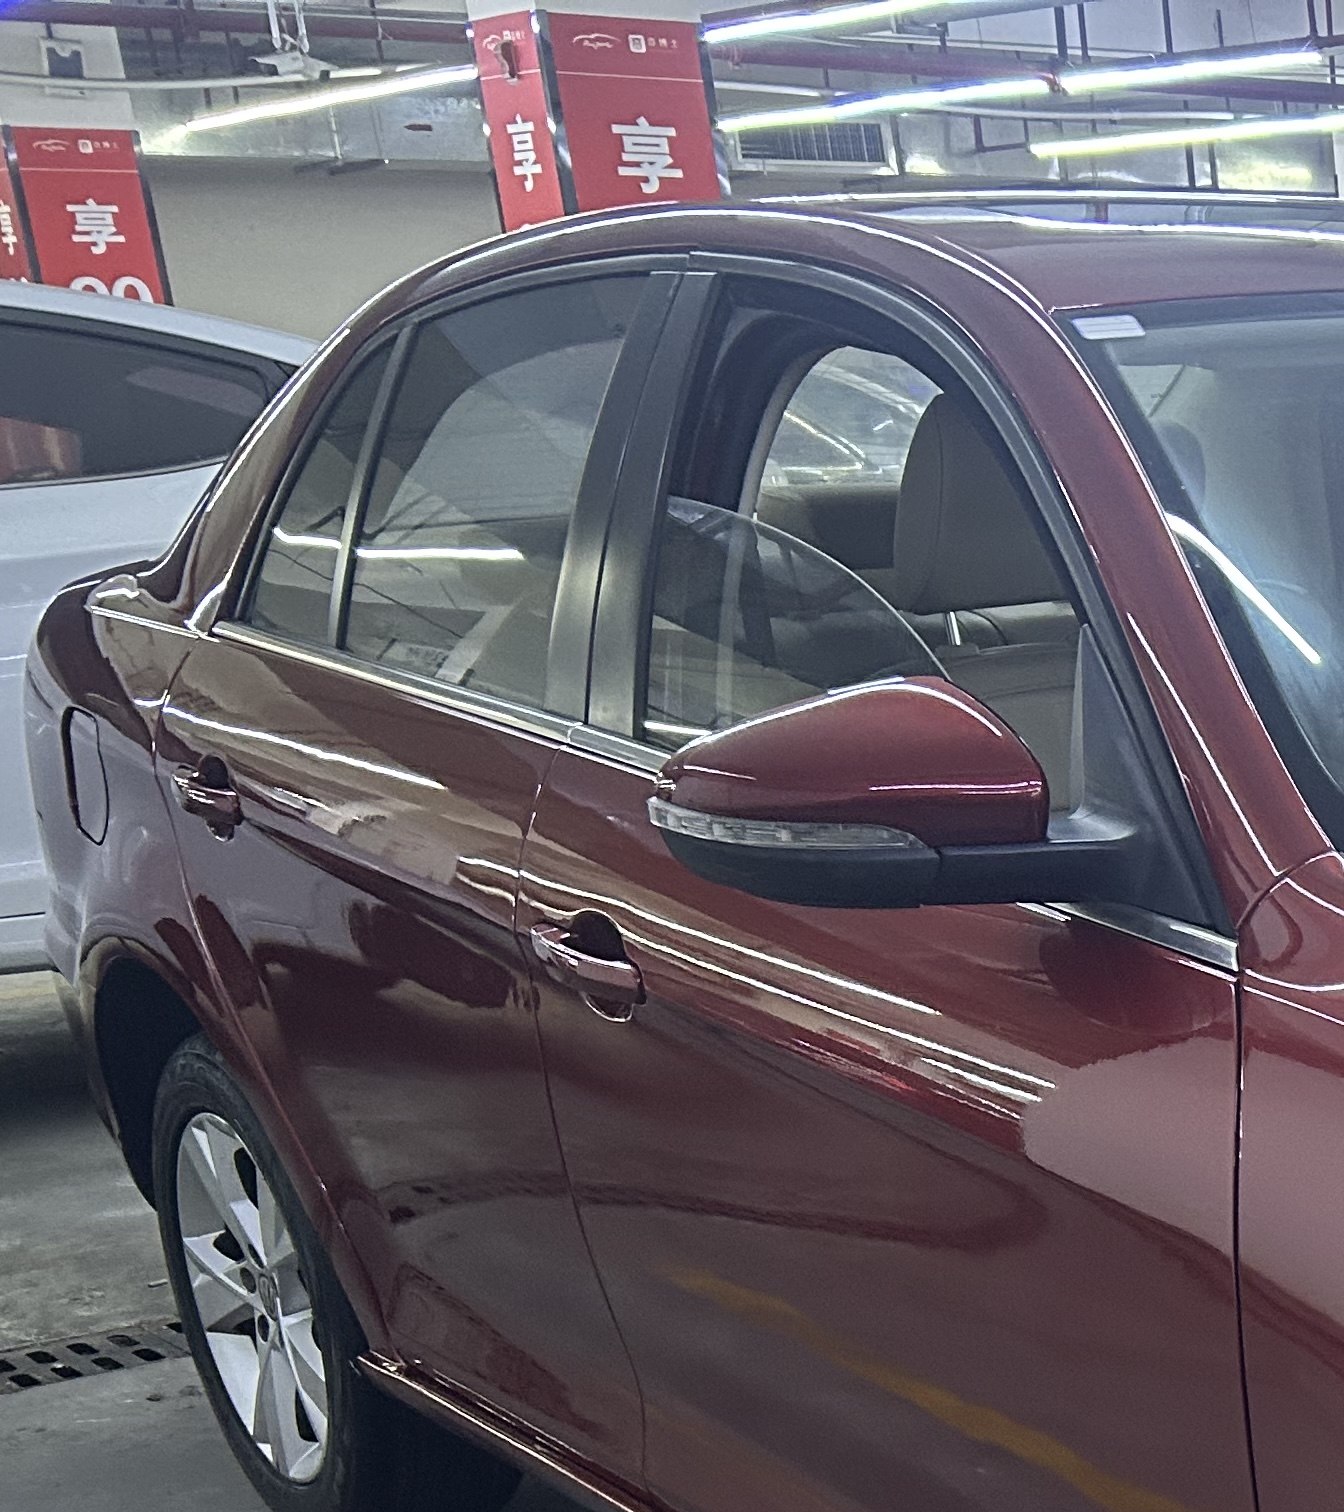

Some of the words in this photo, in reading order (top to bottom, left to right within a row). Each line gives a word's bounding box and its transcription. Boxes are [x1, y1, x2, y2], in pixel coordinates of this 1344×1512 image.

[506, 113, 543, 193] 享
[611, 116, 684, 194] 享
[66, 198, 126, 254] 享
